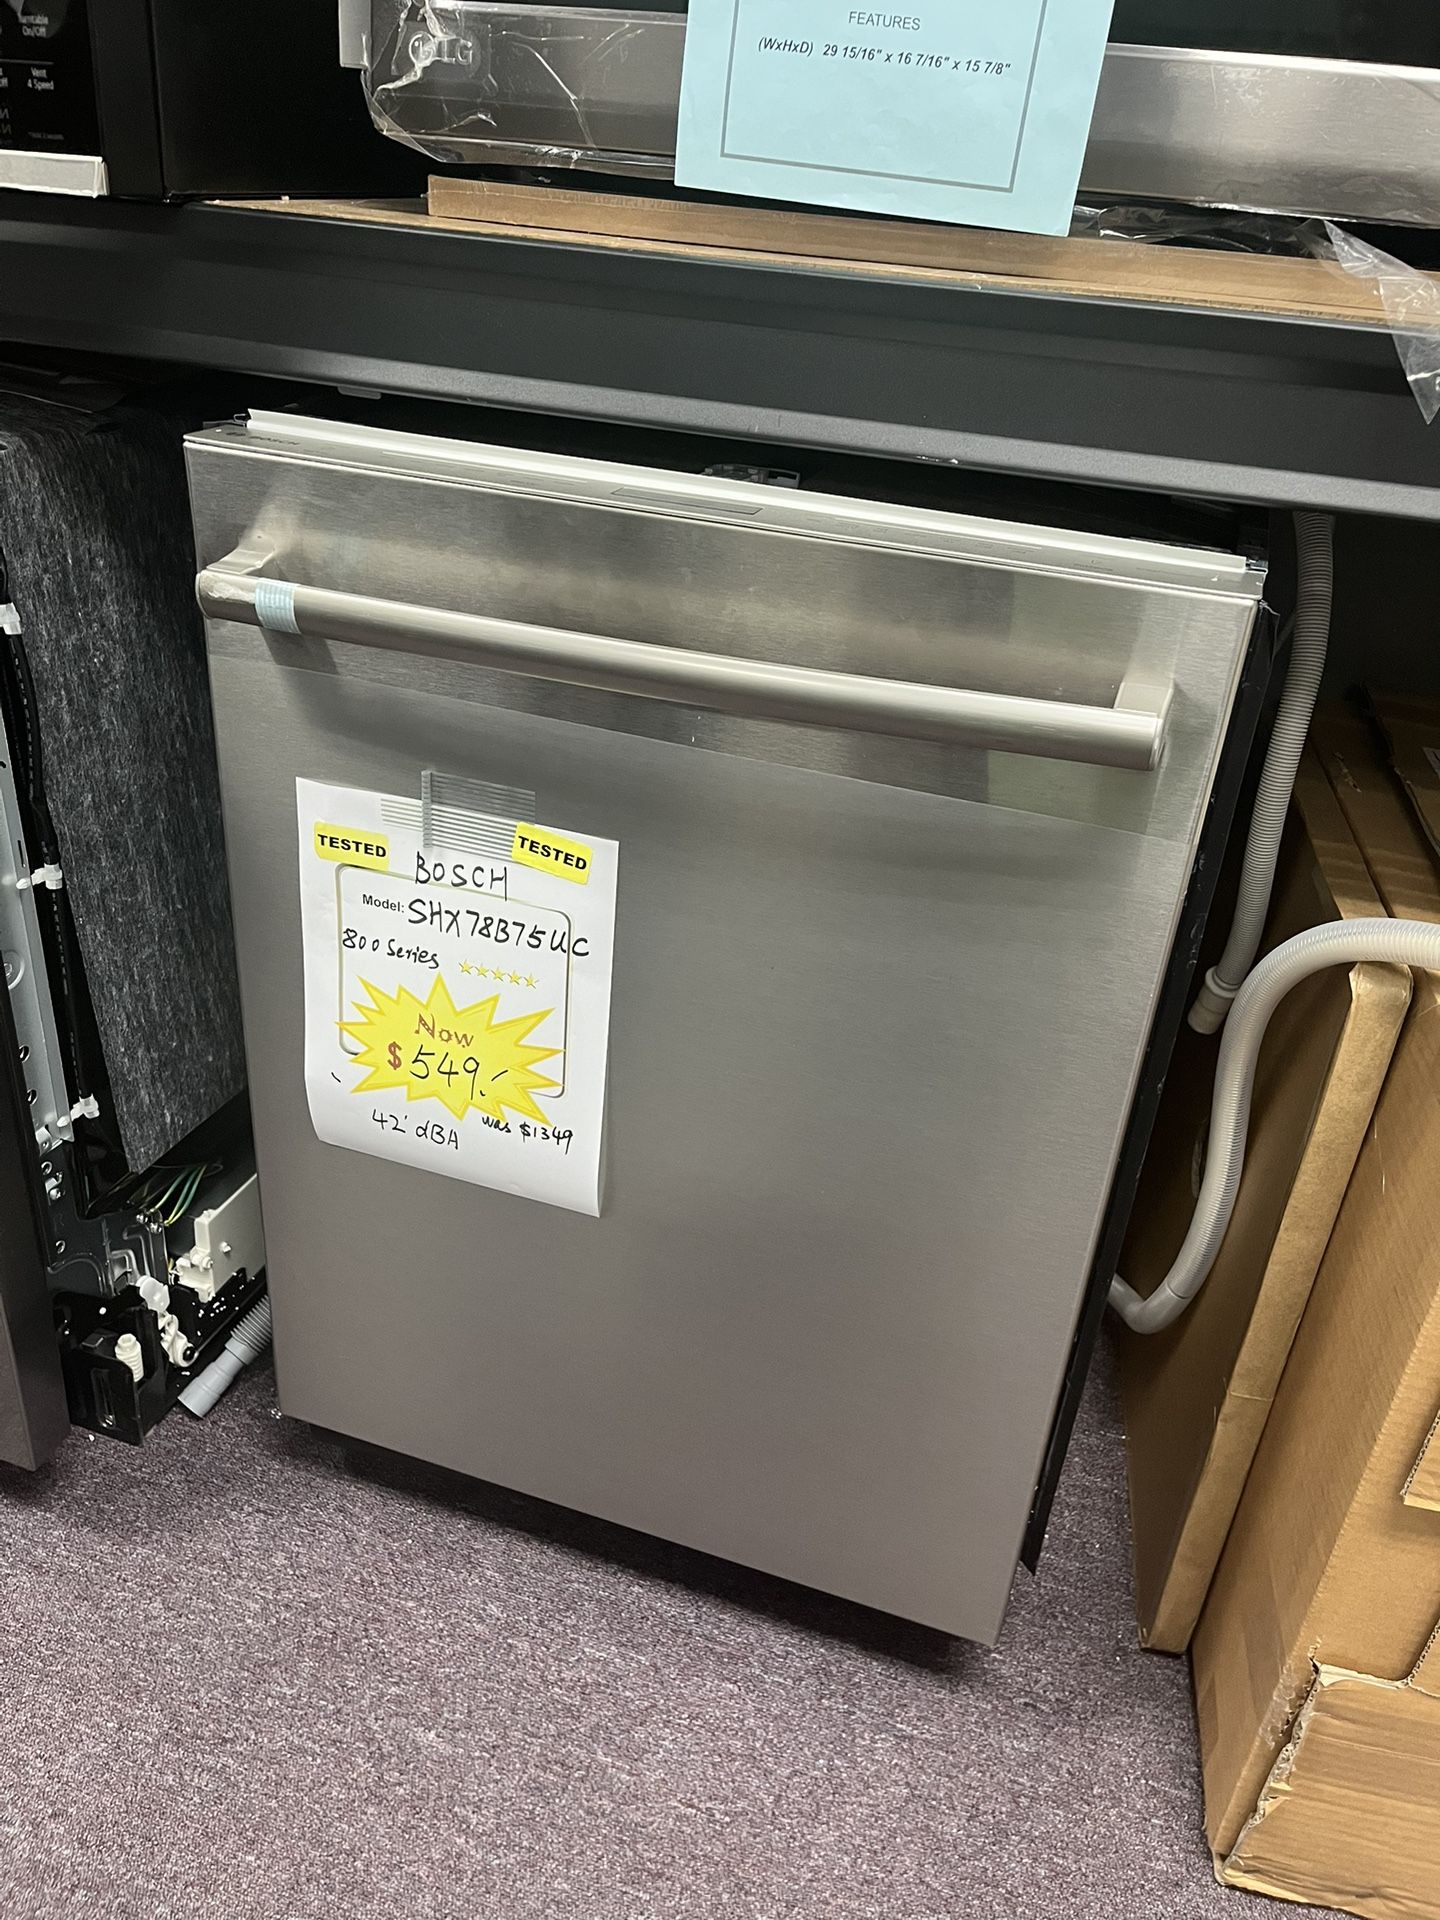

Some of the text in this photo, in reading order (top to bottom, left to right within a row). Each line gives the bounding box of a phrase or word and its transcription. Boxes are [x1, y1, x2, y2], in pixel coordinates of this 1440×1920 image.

[22, 25, 46, 38] On/Off
[848, 10, 920, 31] FEATURES
[441, 38, 473, 65] LG
[758, 36, 1011, 76] (WxHxD) 29 15/16" x 16 7/16" x 15 7/8"
[27, 78, 55, 91] 4 Speed
[30, 66, 47, 78] Vent
[317, 833, 387, 858] TESTED
[518, 835, 587, 871] TESTED
[415, 851, 508, 901] BOSCH
[362, 893, 405, 914] Model:
[342, 927, 440, 970] 800 Series
[416, 1119, 459, 1150] dBA
[482, 1115, 574, 1155] was $1349
